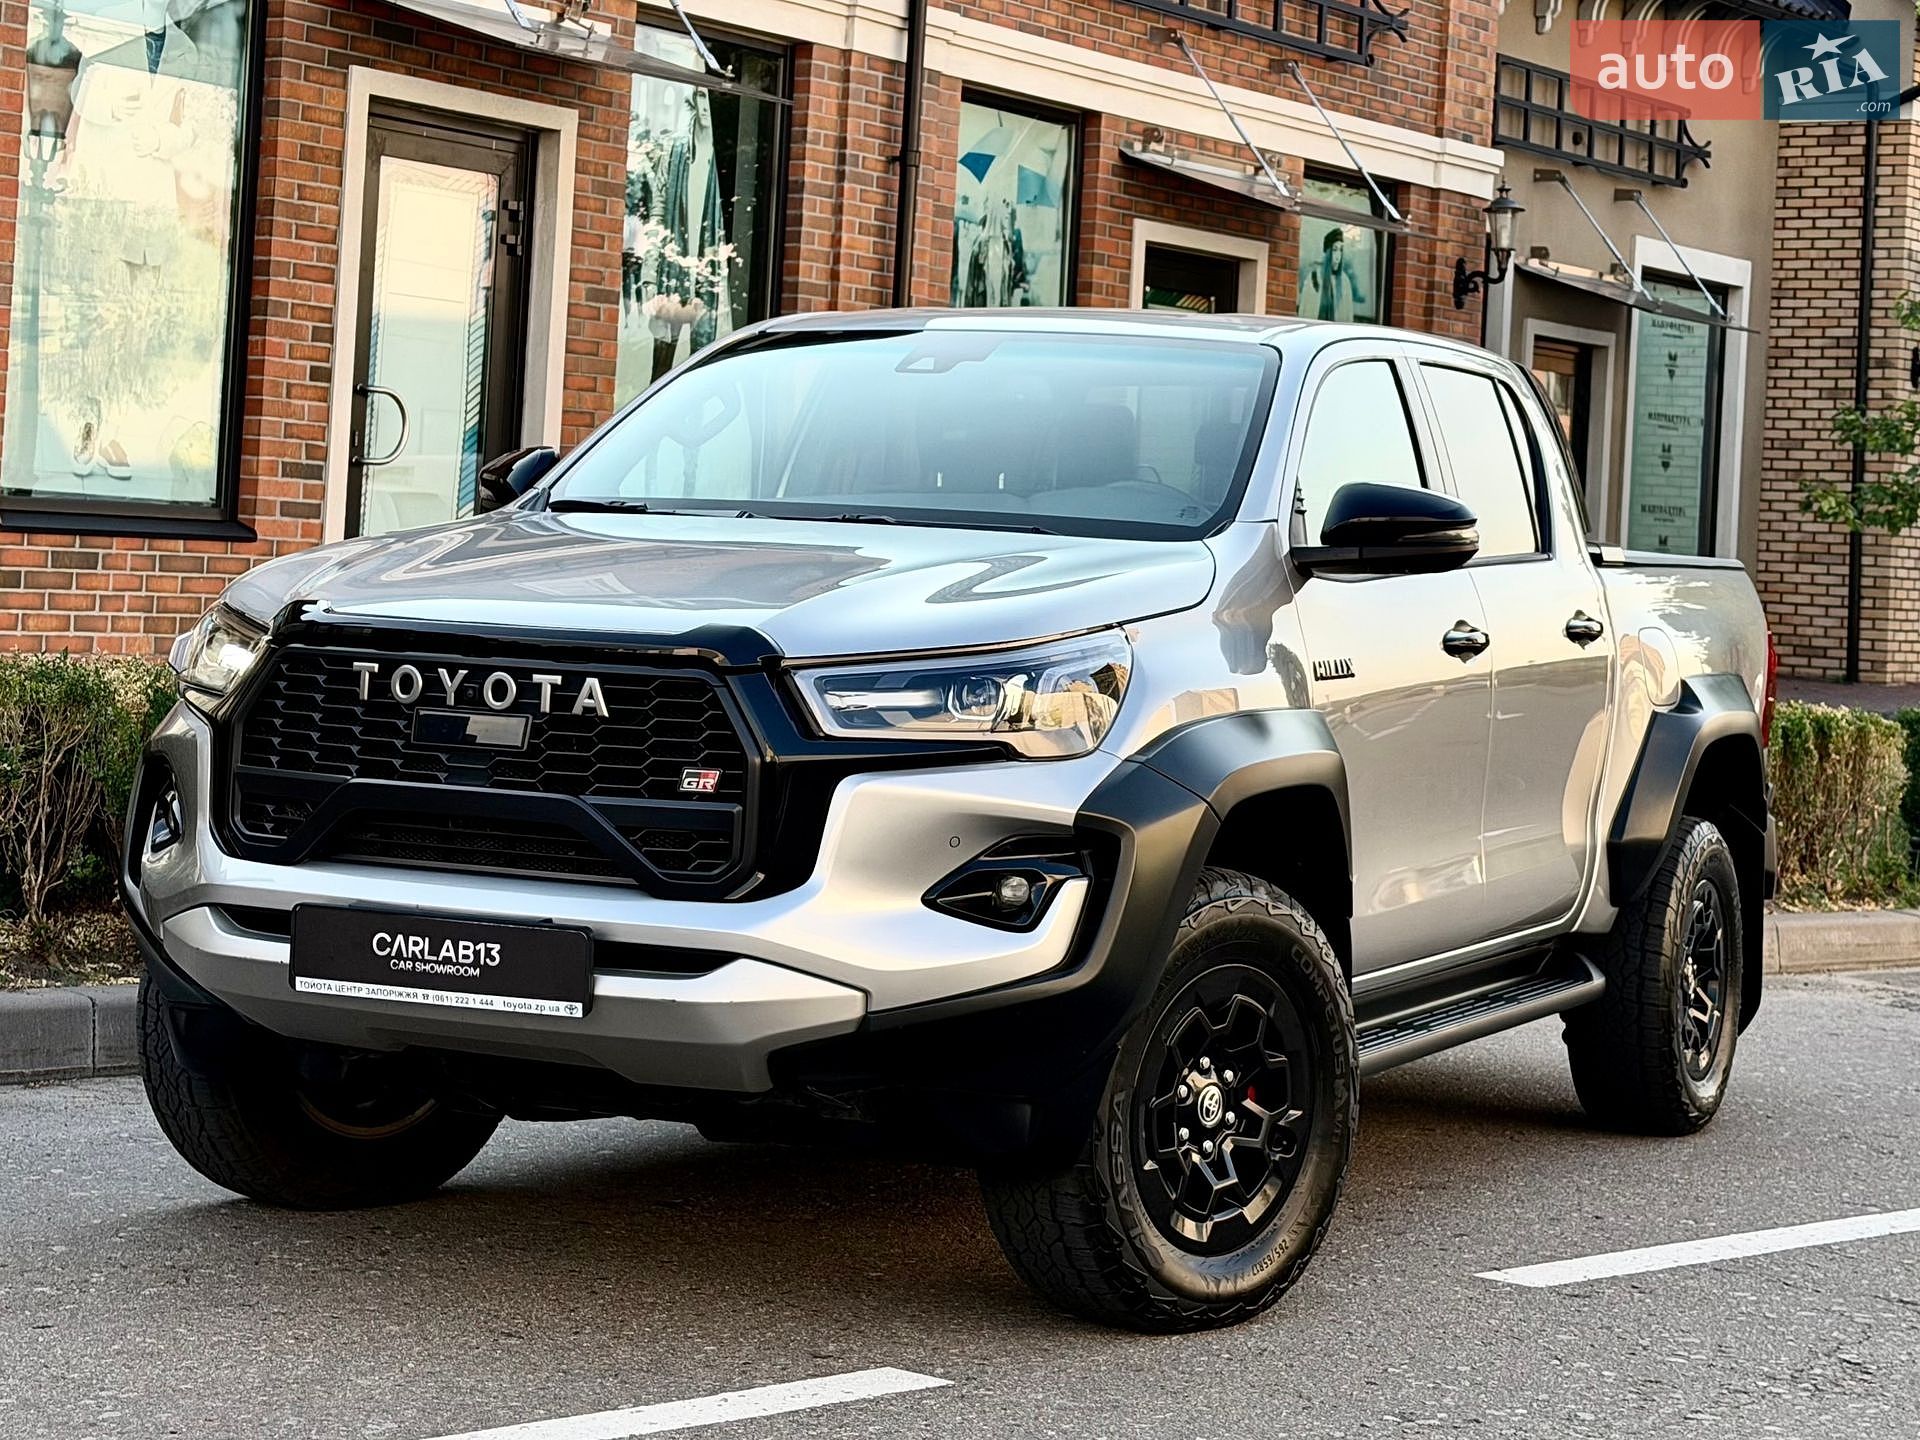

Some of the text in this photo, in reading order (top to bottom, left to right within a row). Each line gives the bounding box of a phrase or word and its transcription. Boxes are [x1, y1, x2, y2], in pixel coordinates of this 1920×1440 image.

[352, 661, 609, 718] TOYOTA
[682, 777, 715, 790] GR
[372, 932, 501, 967] CARLAB13
[390, 959, 480, 978] CAR SHOWROOM
[299, 980, 333, 992] ТОЙОТА
[335, 984, 363, 996] ЦЕНТР
[365, 987, 419, 1000] ЗАПОРІЖЖЯ
[455, 995, 470, 1005] 222
[479, 998, 494, 1007] 444
[1251, 1239, 1290, 1276] 265/65R17
